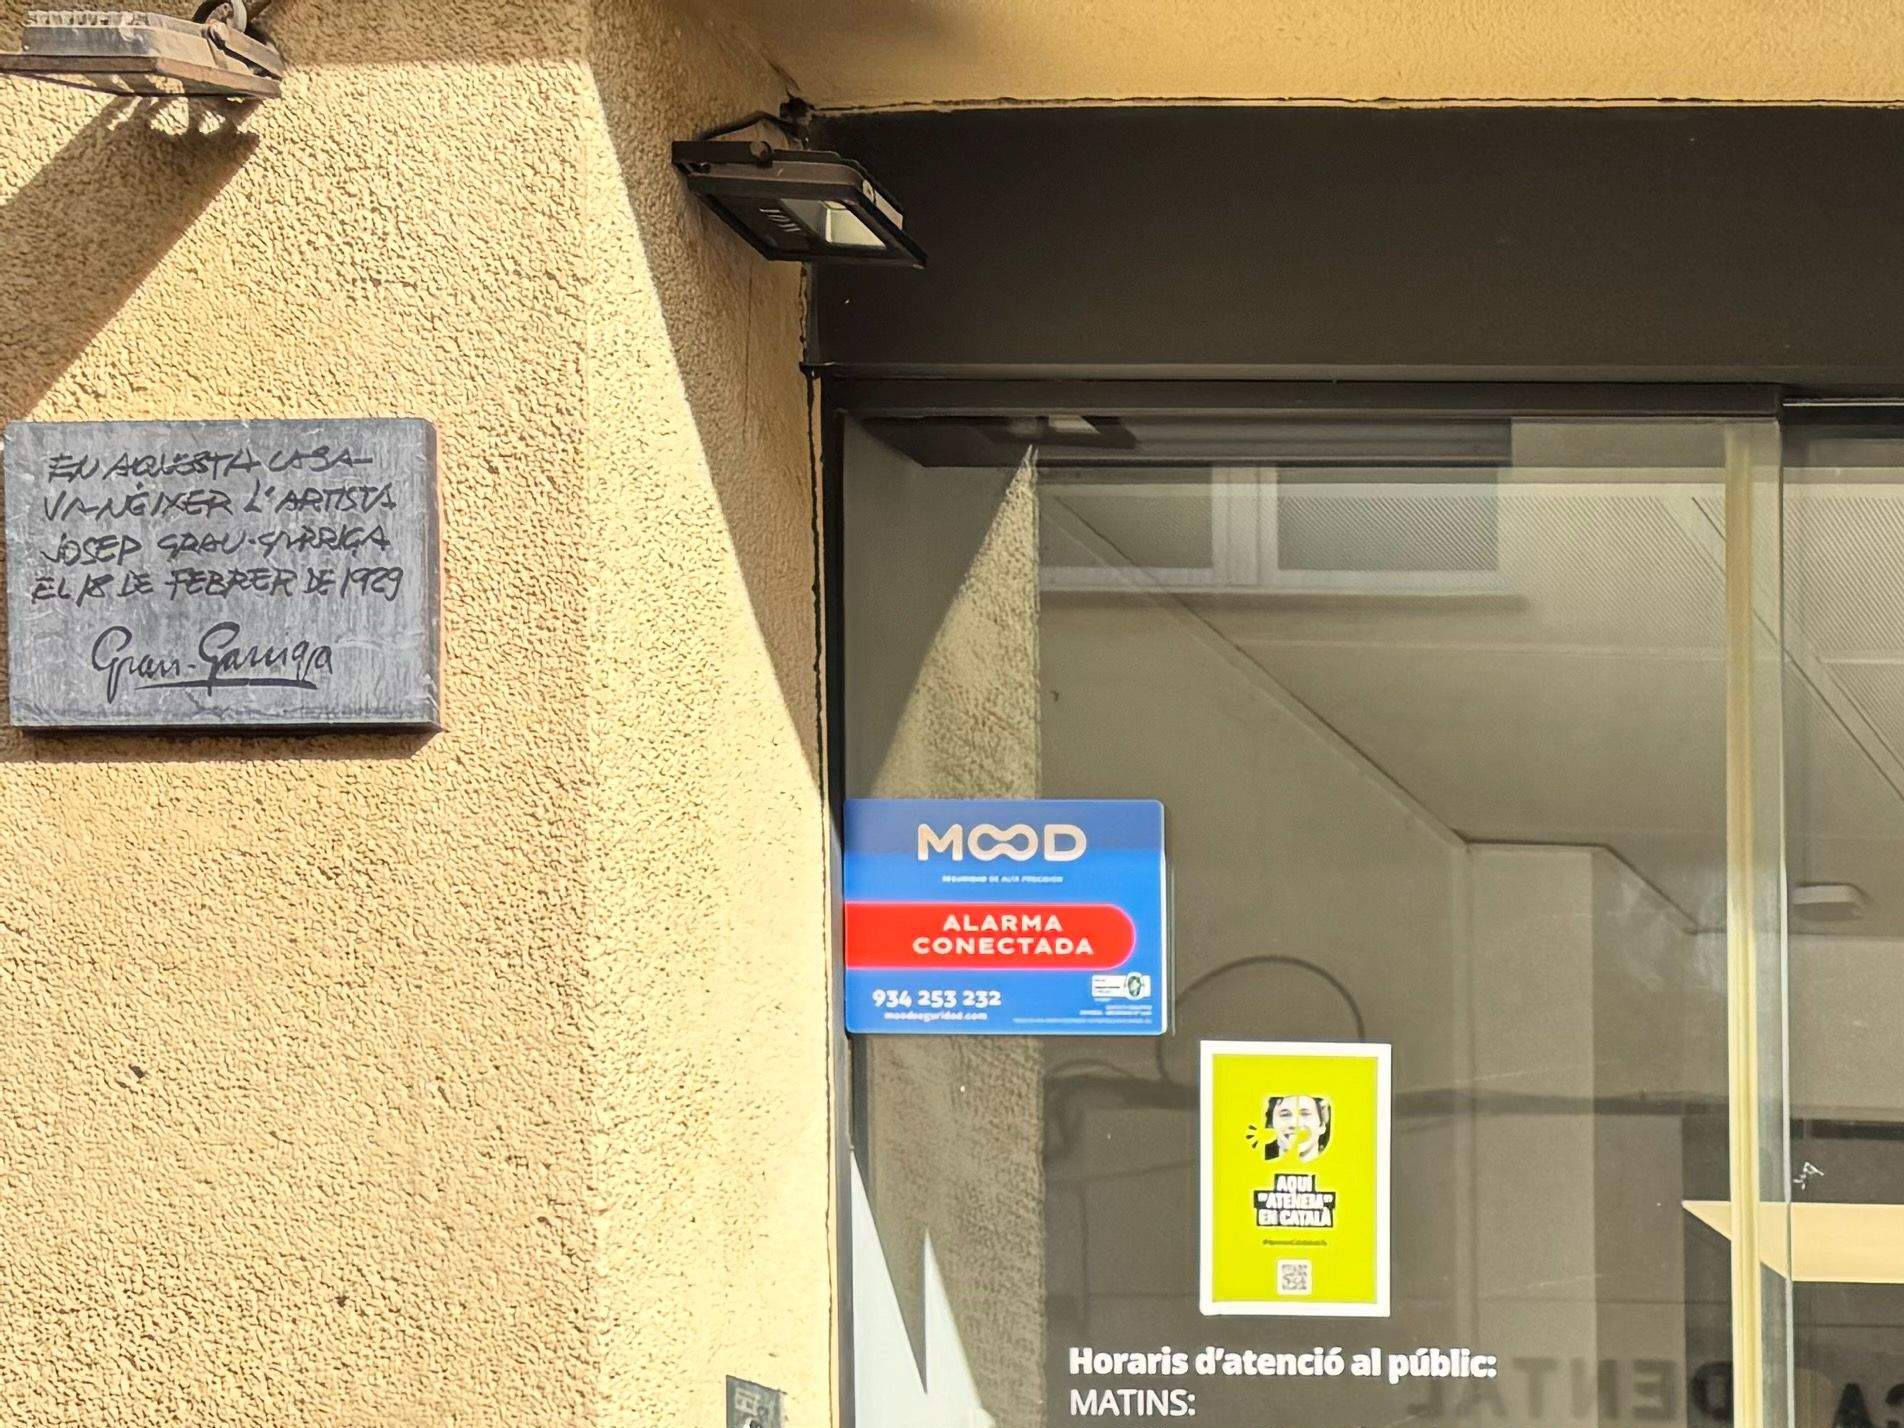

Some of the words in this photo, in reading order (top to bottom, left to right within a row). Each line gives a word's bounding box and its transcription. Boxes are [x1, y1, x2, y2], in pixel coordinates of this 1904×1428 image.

[48, 453, 100, 483] EN
[40, 533, 142, 566] JOSEP
[31, 577, 70, 603] EL
[117, 570, 153, 596] DE
[165, 567, 298, 600] FEBRER
[303, 567, 336, 595] DE
[917, 824, 1087, 861] MOOD
[942, 914, 1063, 932] ALARMA
[912, 937, 1094, 955] CONECTADA
[872, 989, 912, 1008] 934
[917, 989, 957, 1008] 253
[962, 989, 1002, 1008] 232
[1068, 1347, 1188, 1376] Horaris
[1195, 1346, 1344, 1377] d'atenció
[1351, 1348, 1380, 1377] al
[1388, 1347, 1497, 1385] públic:
[1070, 1388, 1196, 1417] MATINS:
